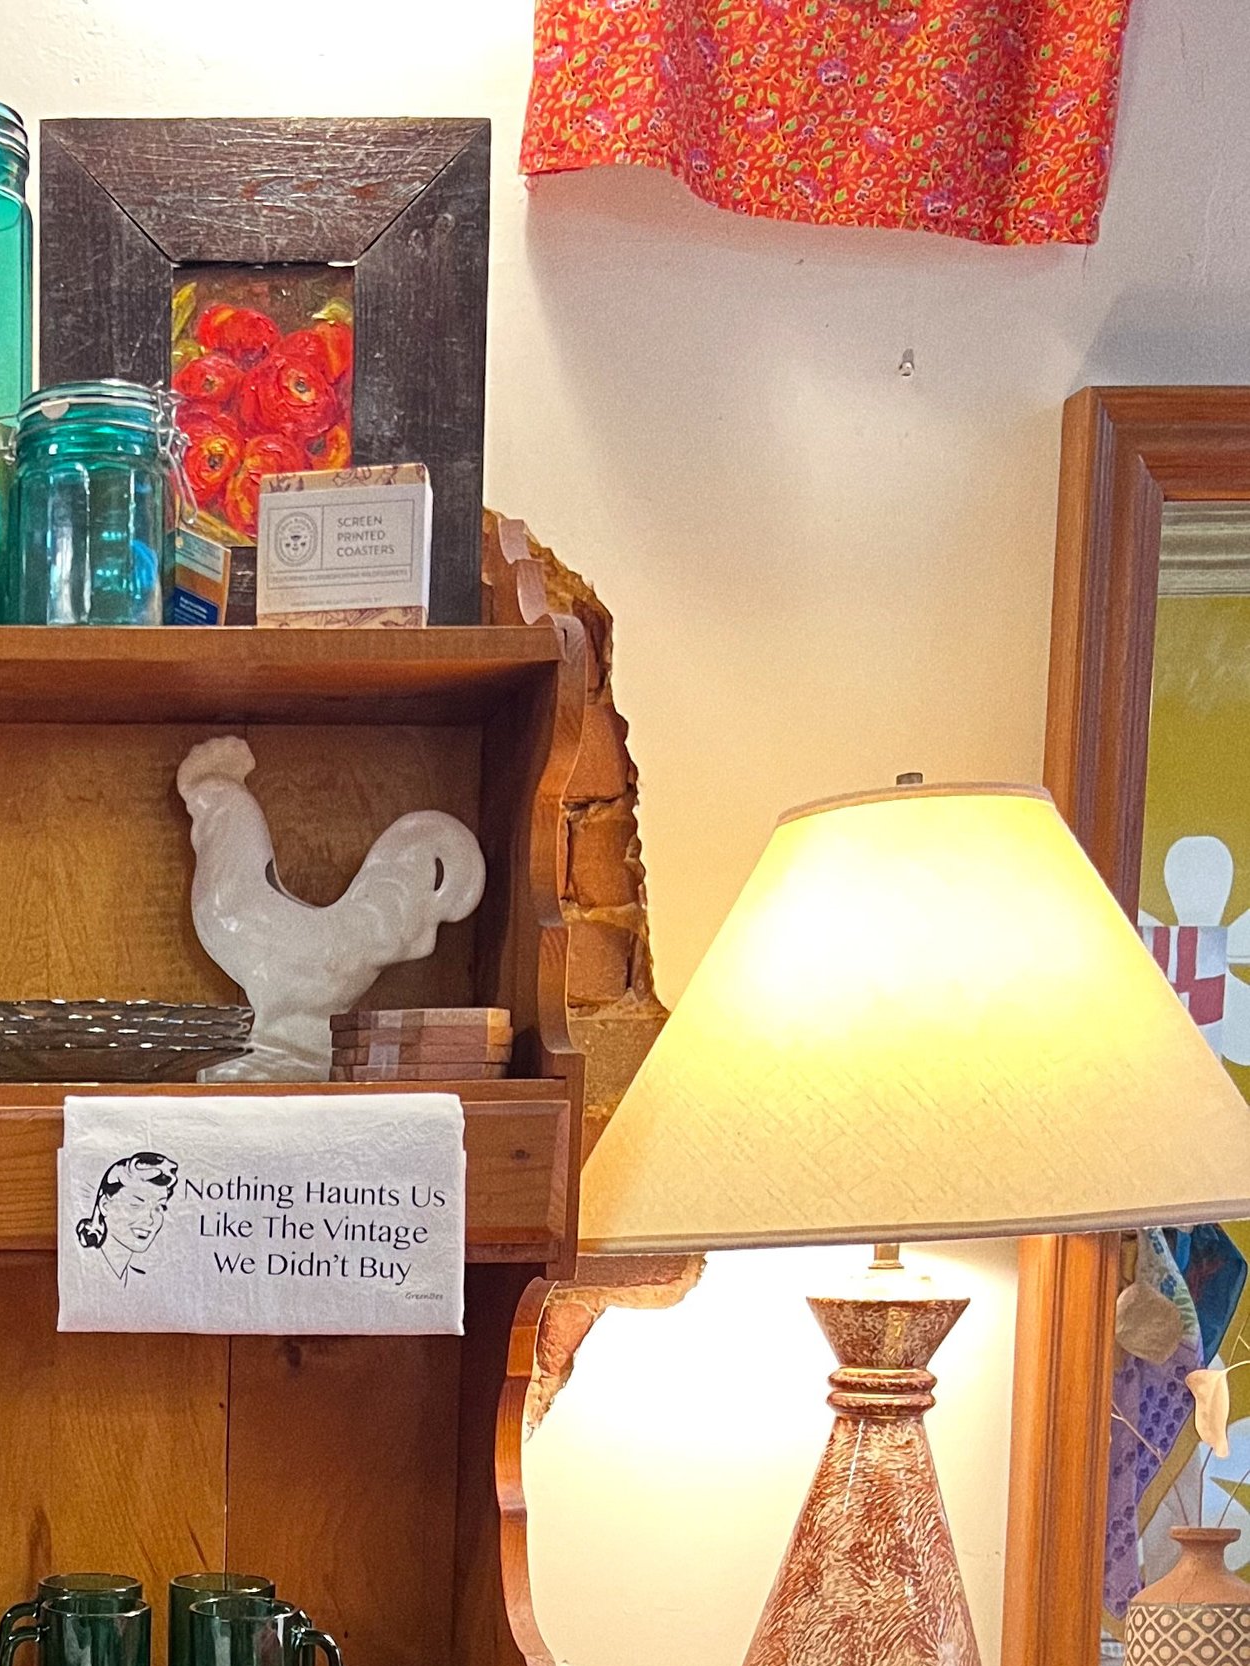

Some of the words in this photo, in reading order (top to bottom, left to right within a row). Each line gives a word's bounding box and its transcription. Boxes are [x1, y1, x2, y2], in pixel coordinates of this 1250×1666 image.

[337, 515, 384, 528] SCREEN
[336, 529, 387, 542] PRINTED
[336, 545, 396, 558] COASTERS
[184, 1175, 295, 1209] Nothing
[306, 1180, 401, 1208] Haunts
[411, 1185, 447, 1208] Us
[199, 1212, 254, 1239] Like
[262, 1214, 316, 1241] The
[323, 1215, 429, 1251] Vintage
[213, 1250, 257, 1275] We
[267, 1251, 351, 1279] Didn't
[359, 1256, 412, 1286] Buy
